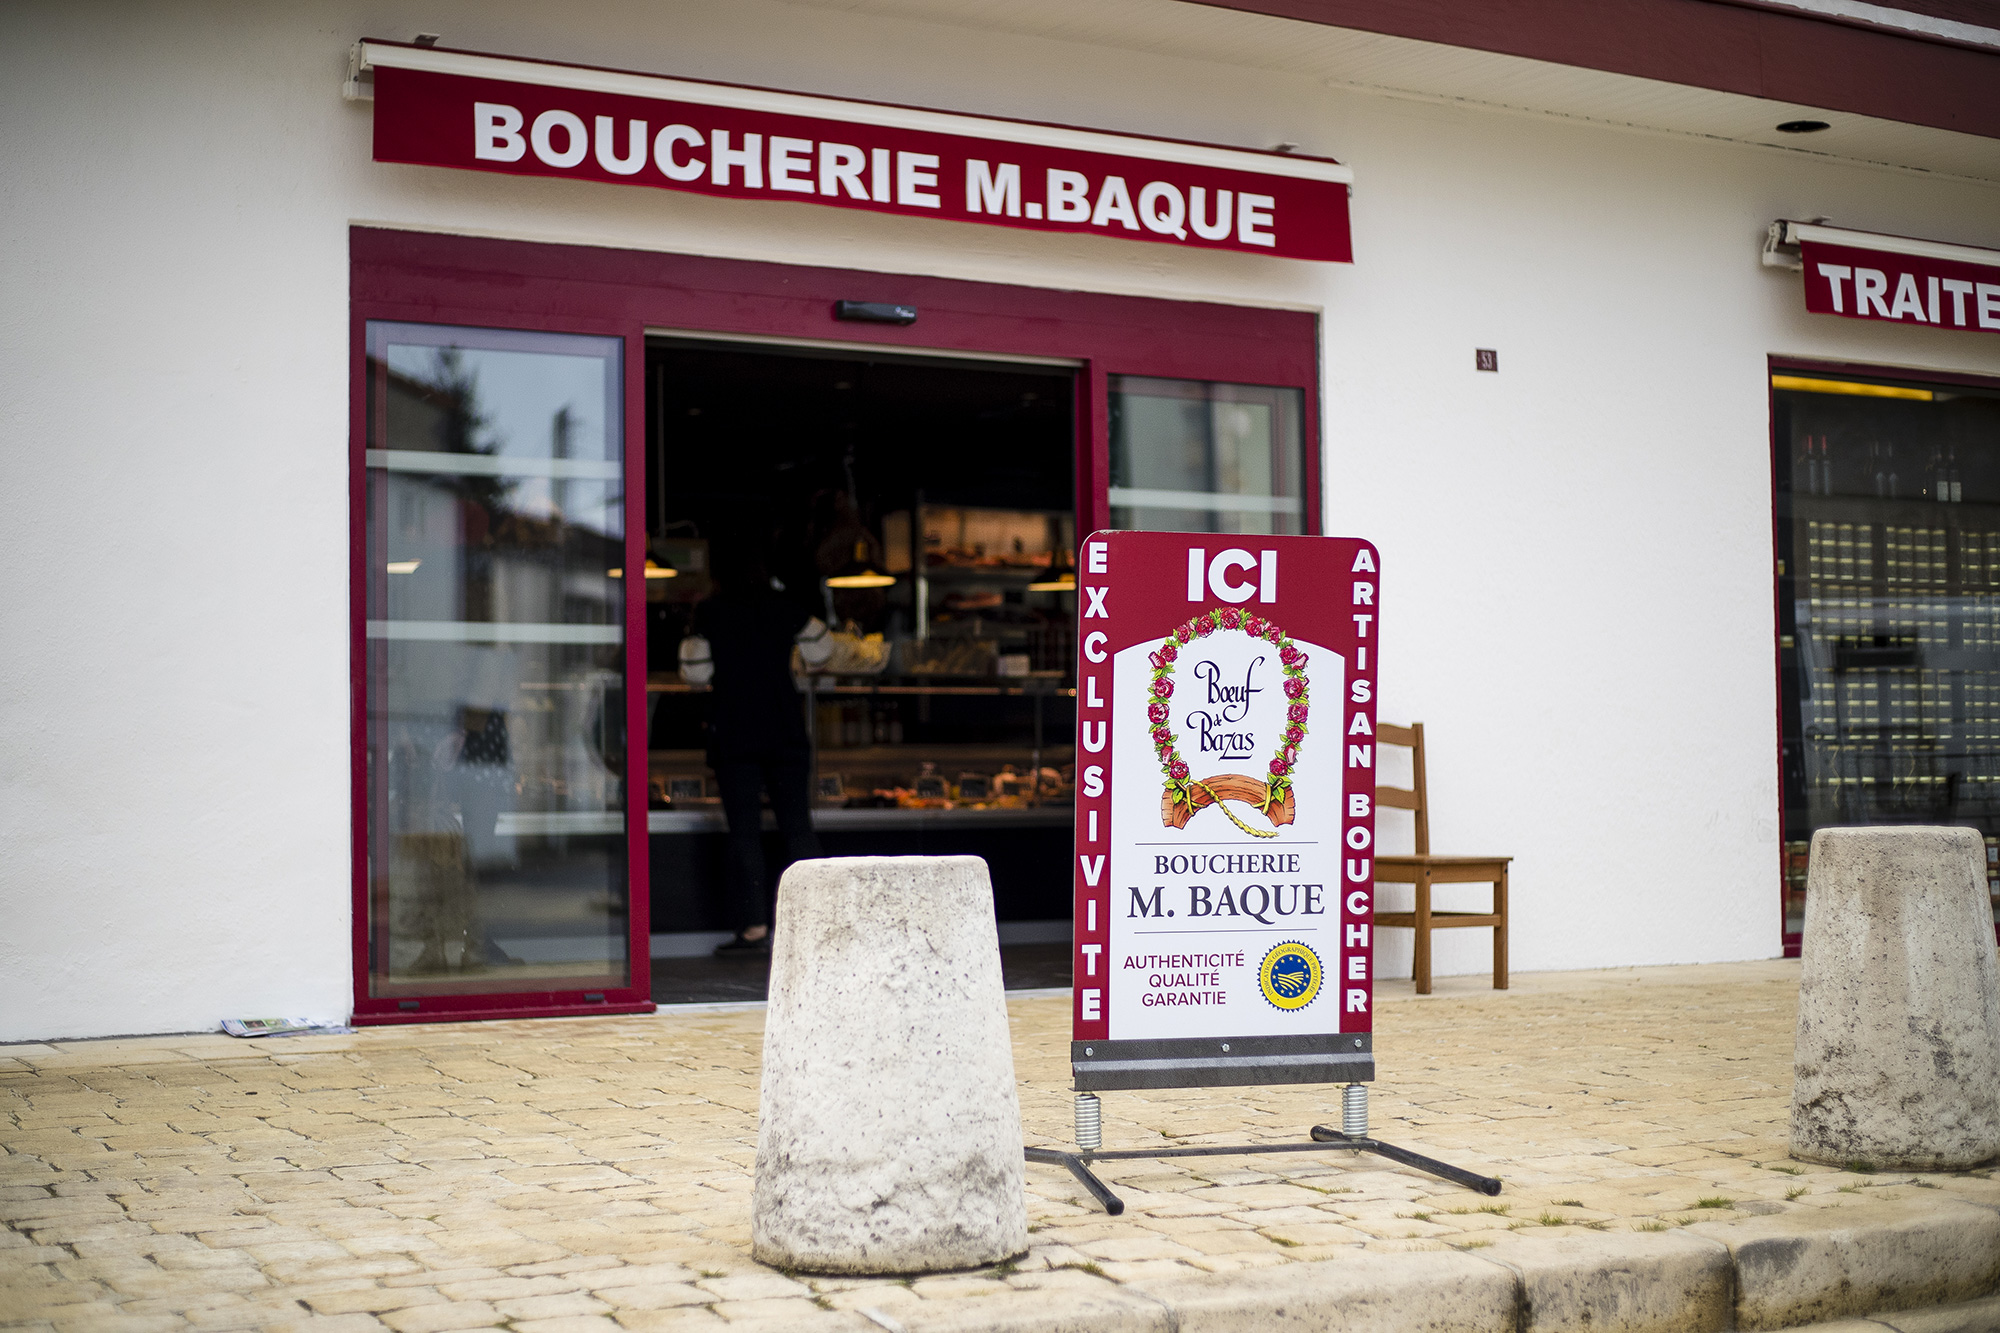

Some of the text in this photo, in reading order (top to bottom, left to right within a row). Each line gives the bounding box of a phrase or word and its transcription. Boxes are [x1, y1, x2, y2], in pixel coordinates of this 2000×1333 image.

[473, 101, 941, 207] BOUCHERIE
[1817, 263, 2000, 329] TRAITE
[1187, 548, 1277, 603] ICI
[1186, 710, 1255, 761] Bazas
[1080, 542, 1108, 1020] EXCLUSIVITE
[1346, 549, 1376, 1012] ARTISAN BOUCHER
[1154, 854, 1300, 874] BOUCHERIE
[1127, 884, 1325, 924] M. BAQUE
[1124, 949, 1244, 969] AUTHENTICITÉ
[1149, 970, 1220, 988] QUALITÉ
[1262, 959, 1275, 996] INDICATION
[1272, 946, 1314, 964] GÉOGRAPHIQUE
[1142, 991, 1226, 1007] GARANTIE
